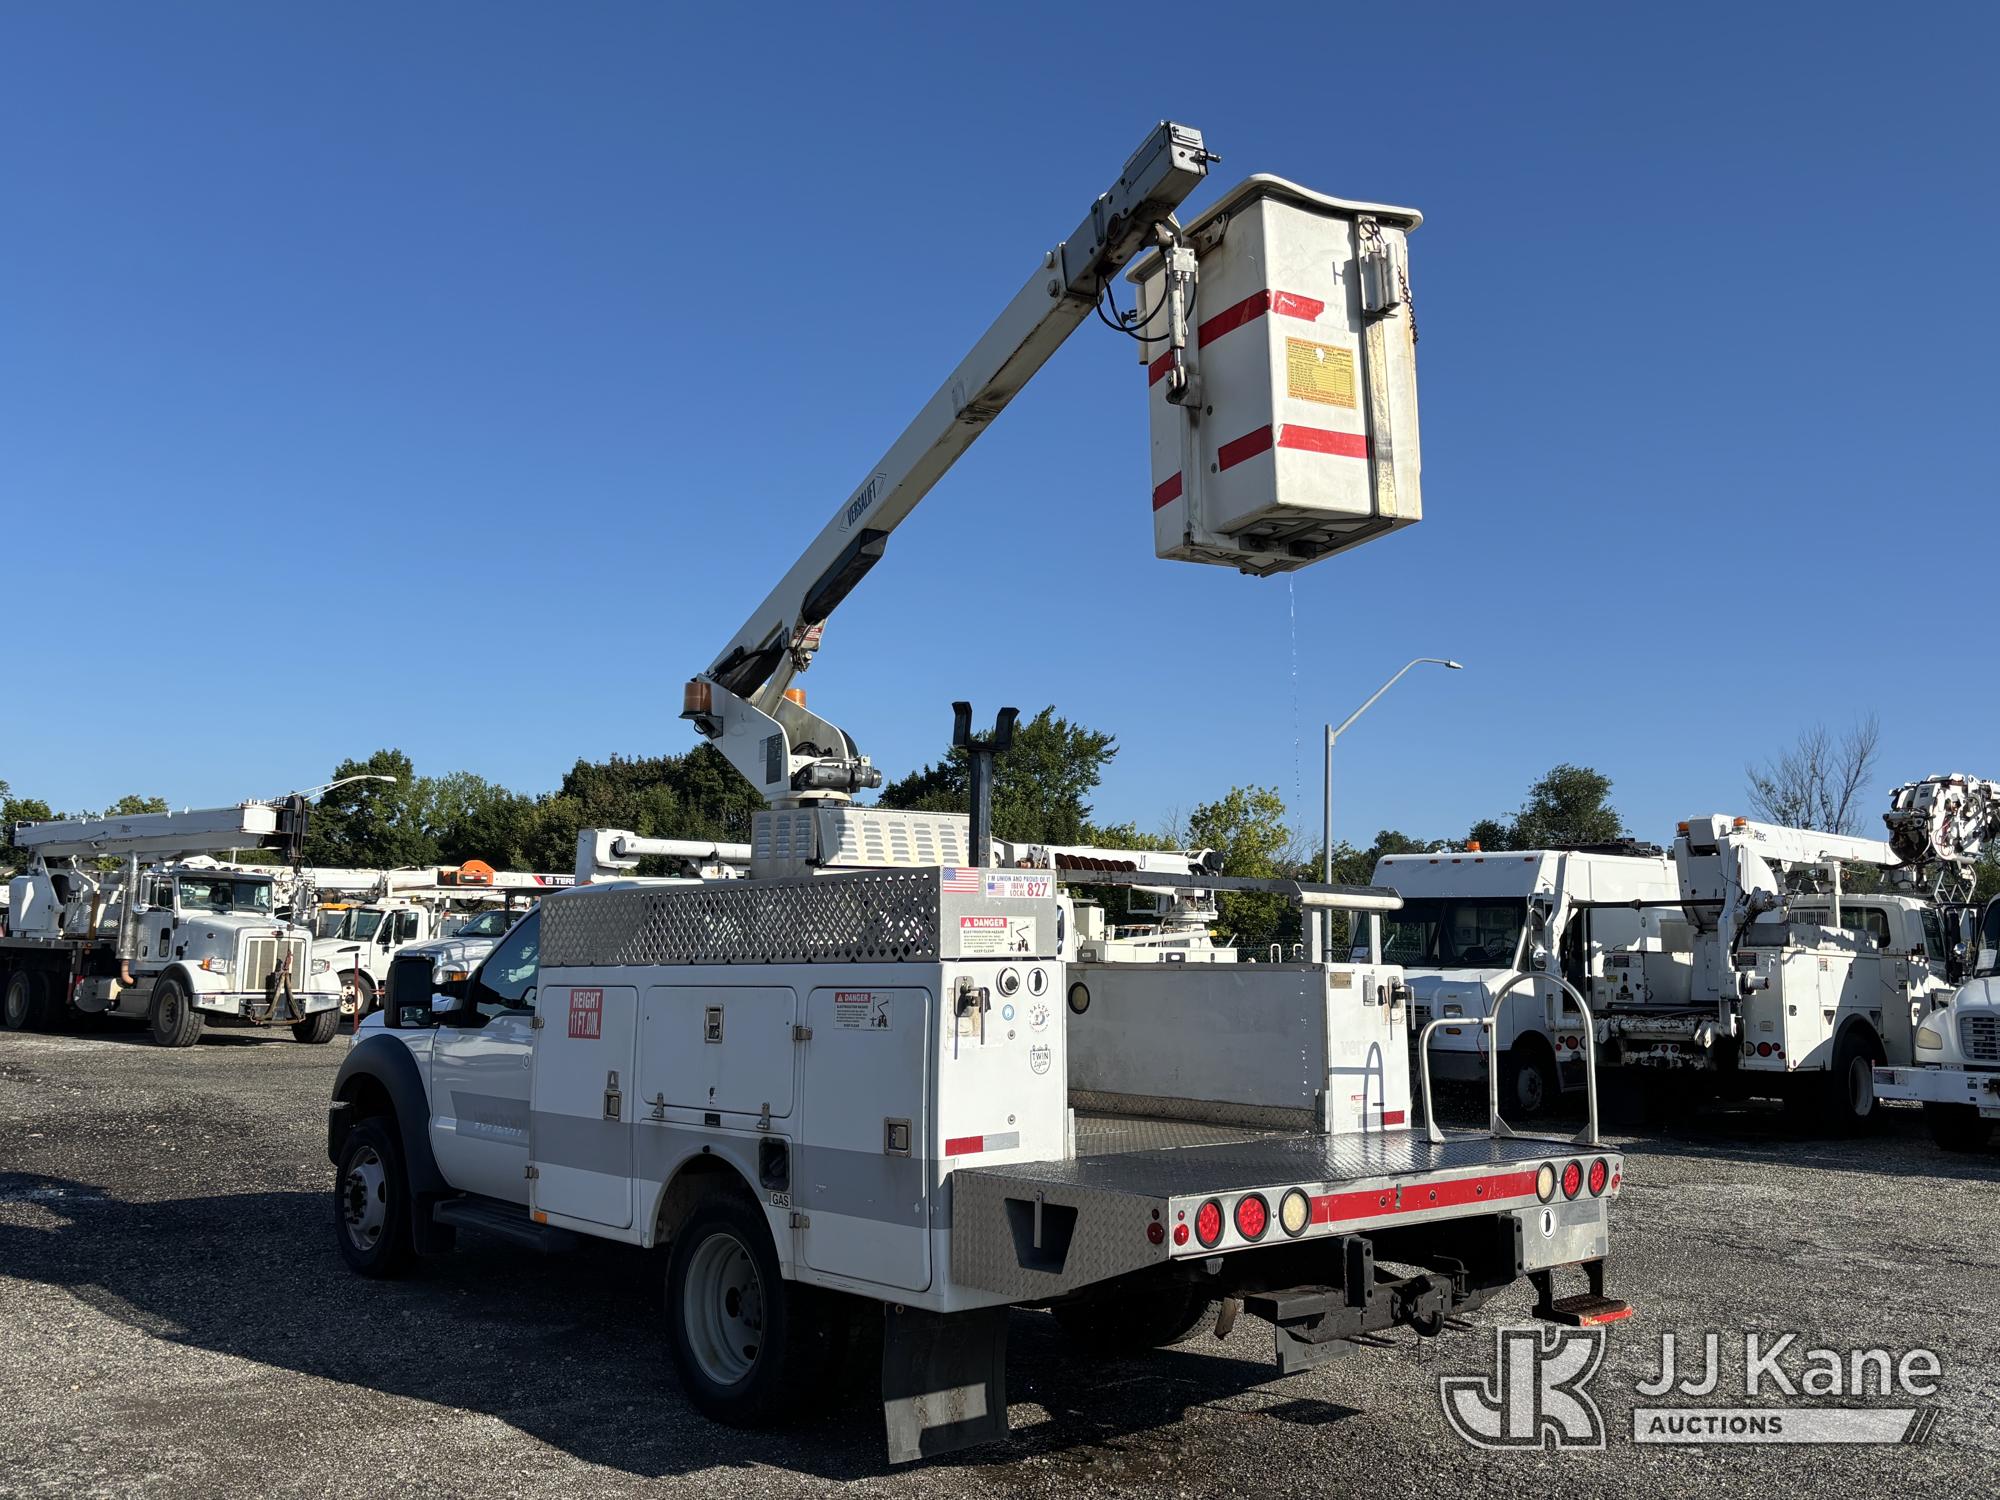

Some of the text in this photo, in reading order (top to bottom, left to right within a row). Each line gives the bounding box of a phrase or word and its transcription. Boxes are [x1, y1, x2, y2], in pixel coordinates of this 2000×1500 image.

[846, 479, 876, 527] VERSALIFT
[554, 877, 576, 885] TERE
[1027, 882, 1048, 897] 827
[973, 918, 1005, 927] DANGER
[573, 992, 600, 1008] HEIGHT
[844, 993, 869, 1002] DANGER
[1032, 1052, 1048, 1060] TWIN
[772, 1193, 789, 1207] GAS
